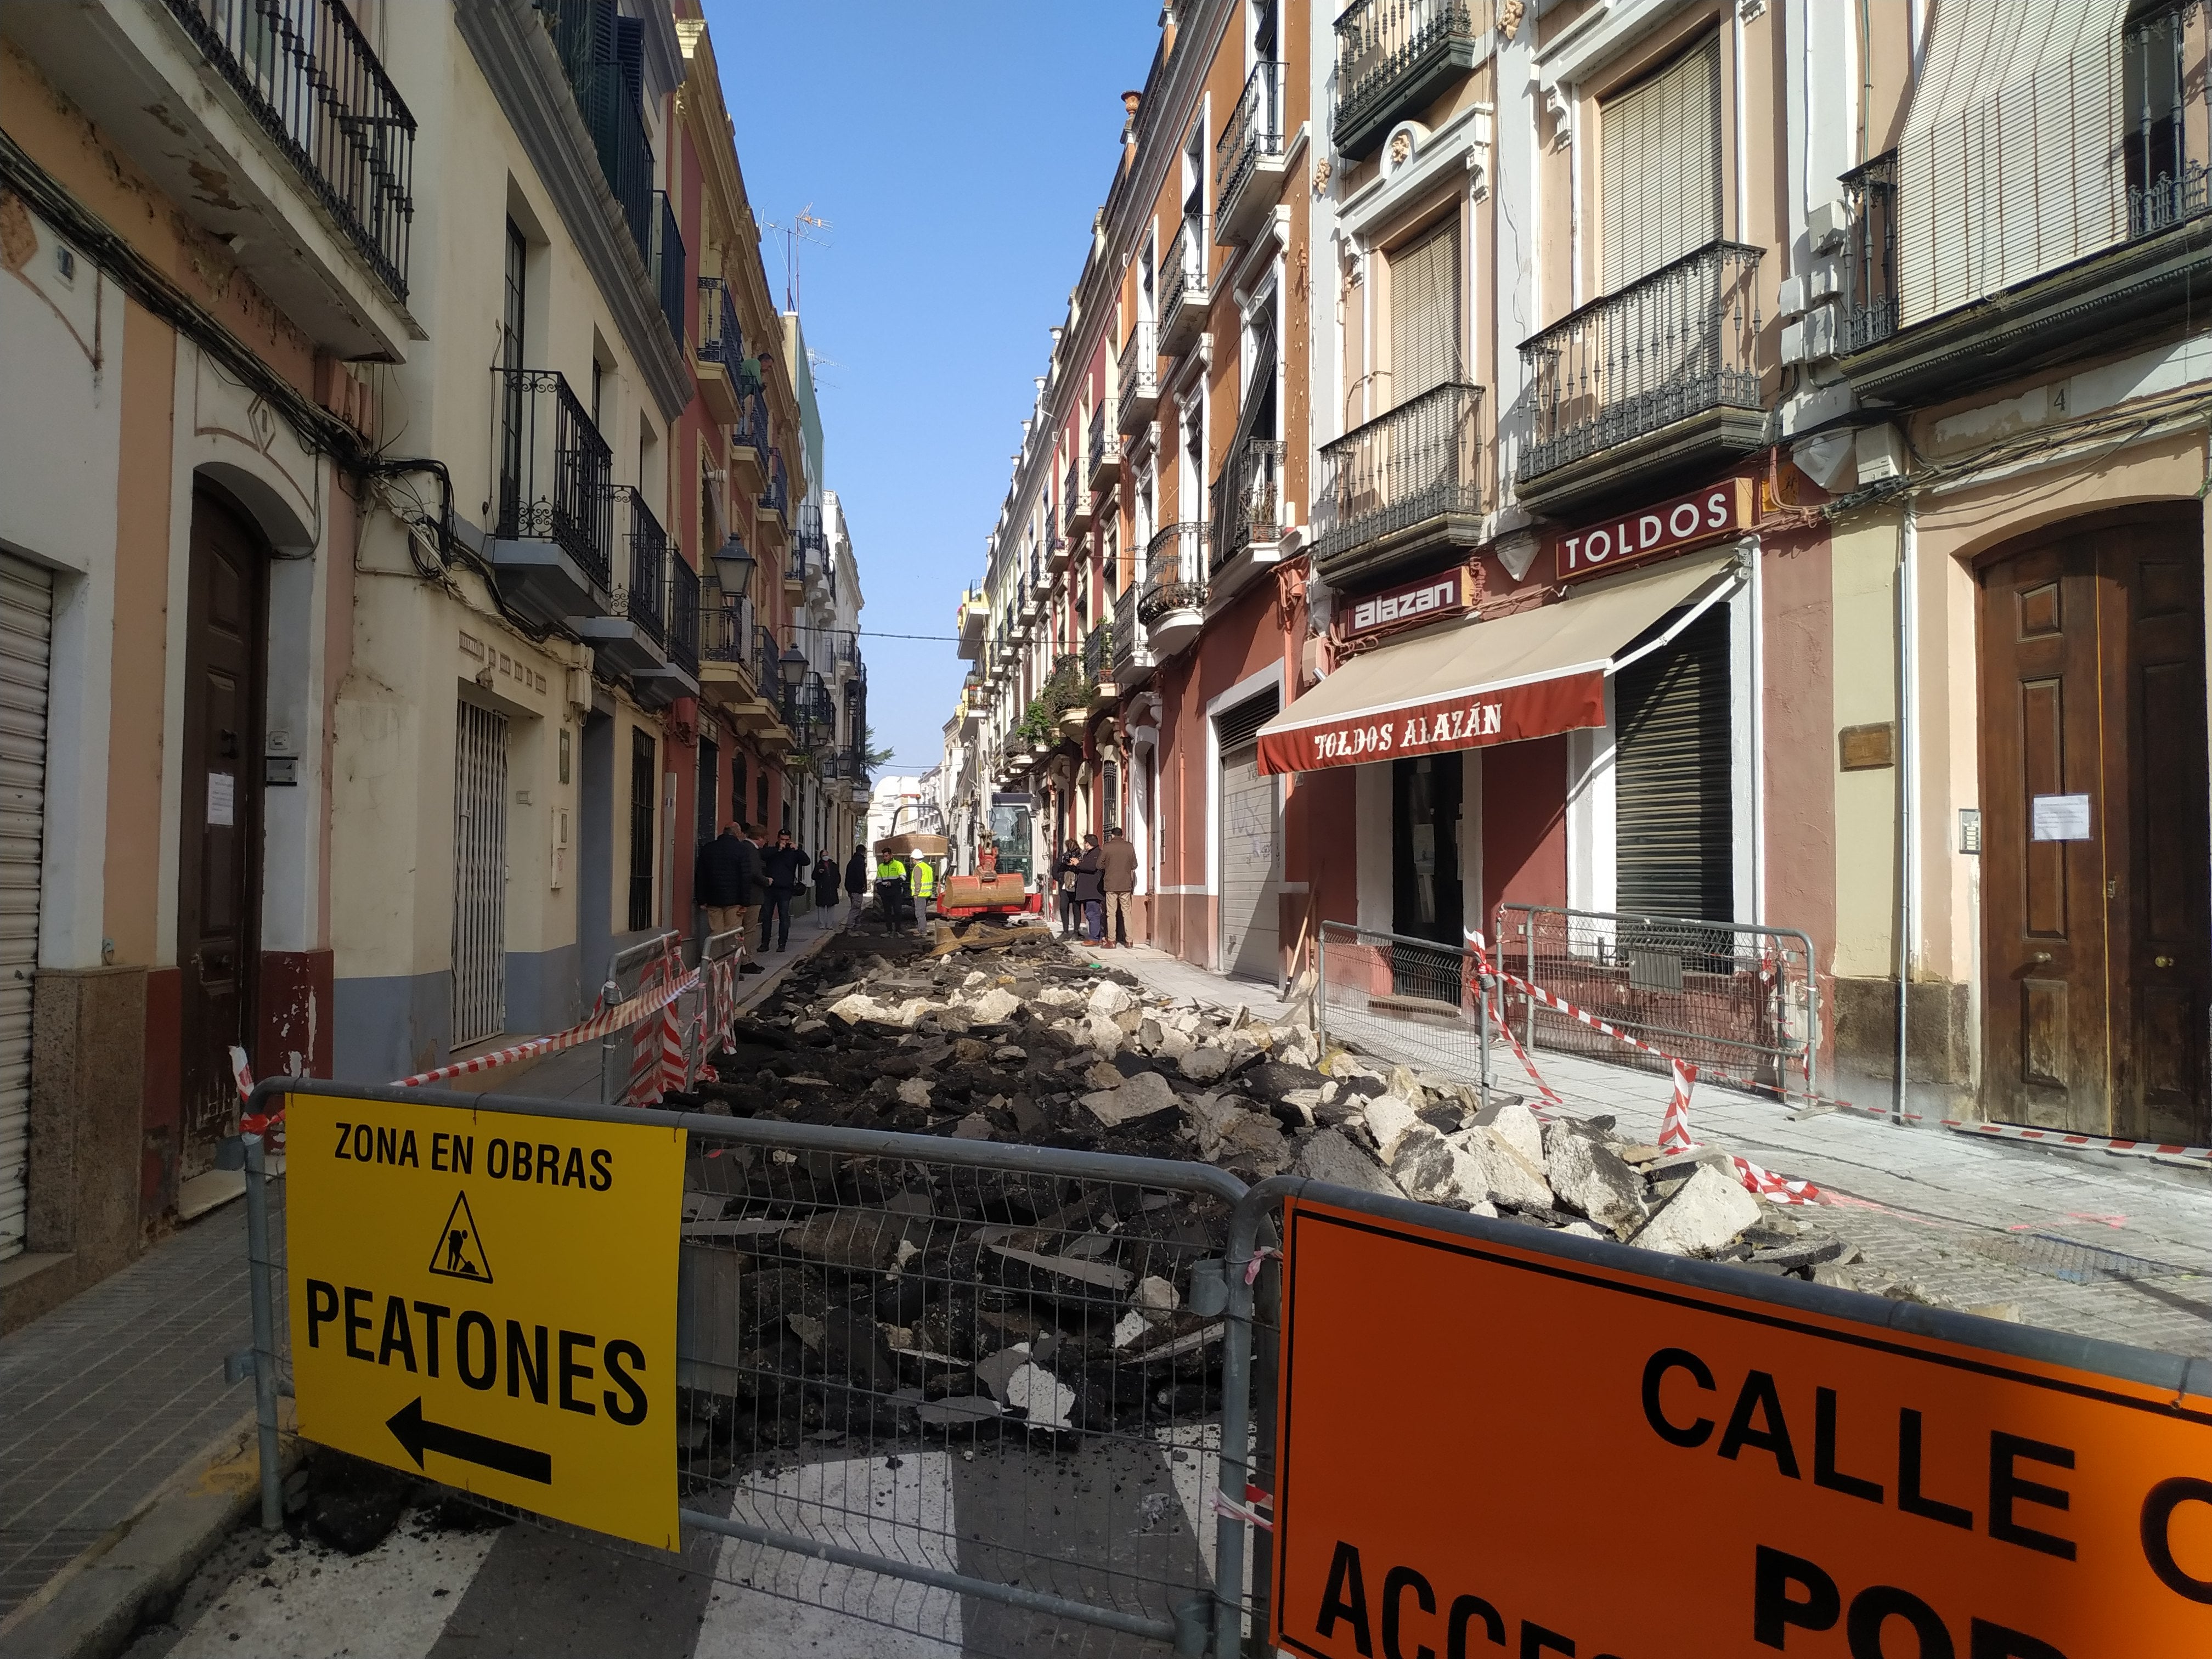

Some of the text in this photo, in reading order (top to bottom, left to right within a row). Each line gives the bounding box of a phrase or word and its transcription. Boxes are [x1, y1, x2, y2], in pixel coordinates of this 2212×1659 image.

[2053, 388, 2066, 411] 4
[1565, 493, 1728, 568] TOLDOS
[1355, 580, 1454, 629] alazan
[1314, 702, 1503, 760] TOLDOS ALAZÁN
[334, 1122, 613, 1192] ZONA EN OBRAS
[306, 1278, 648, 1426] PEATONES
[1641, 1347, 2076, 1562] CALLE
